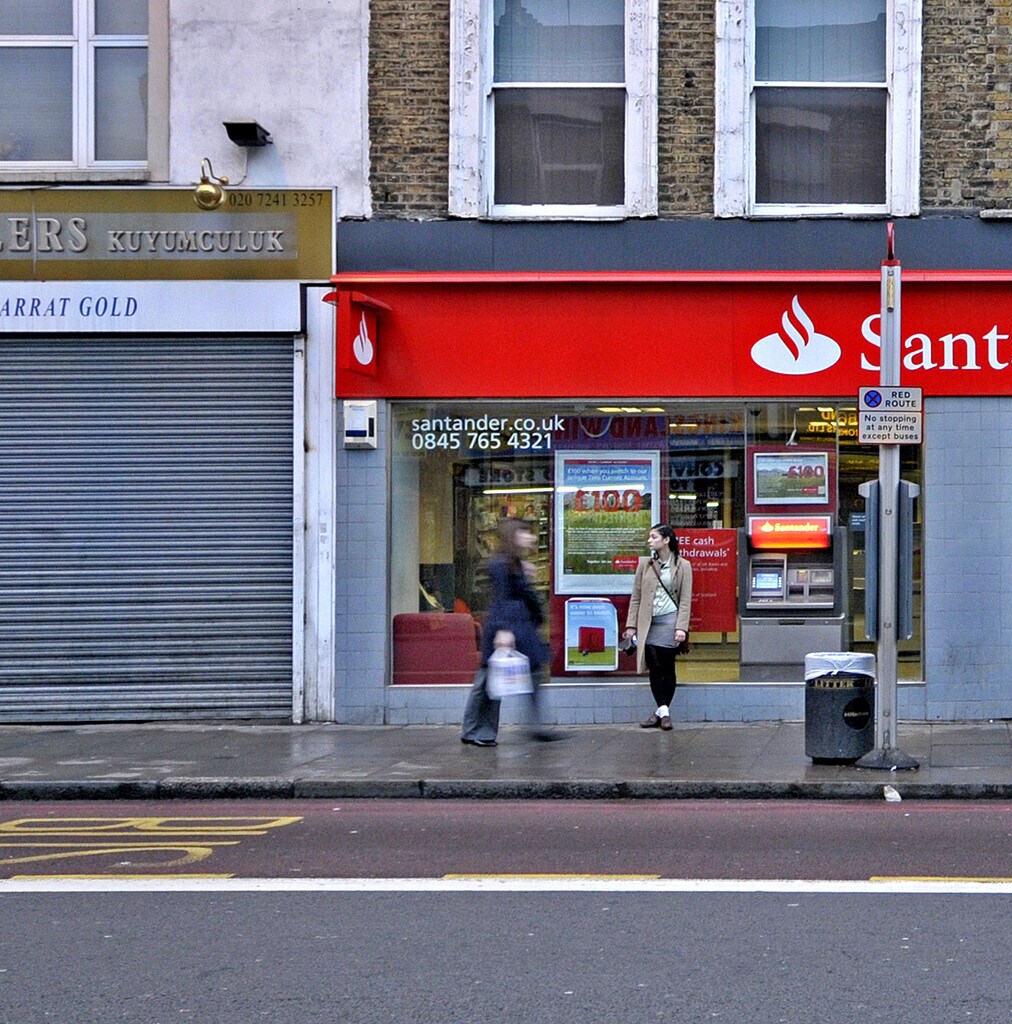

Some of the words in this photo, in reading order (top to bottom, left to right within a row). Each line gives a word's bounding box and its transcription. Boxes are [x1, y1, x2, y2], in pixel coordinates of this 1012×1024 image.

[229, 193, 252, 207] 020
[258, 193, 286, 207] 7241
[293, 193, 323, 207] 3257
[0, 217, 88, 253] ERS
[107, 230, 284, 253] KUYUMCULUK
[79, 296, 138, 318] GOLD
[411, 414, 565, 432] santander.co.uk
[879, 415, 917, 423] stopping
[412, 433, 460, 450] 0845
[467, 433, 501, 450] 765
[507, 433, 551, 450] 4321
[788, 465, 824, 478] £100
[574, 489, 643, 513] £100
[774, 522, 819, 532] Santander
[693, 536, 714, 545] cash
[815, 680, 854, 688] LITTER
